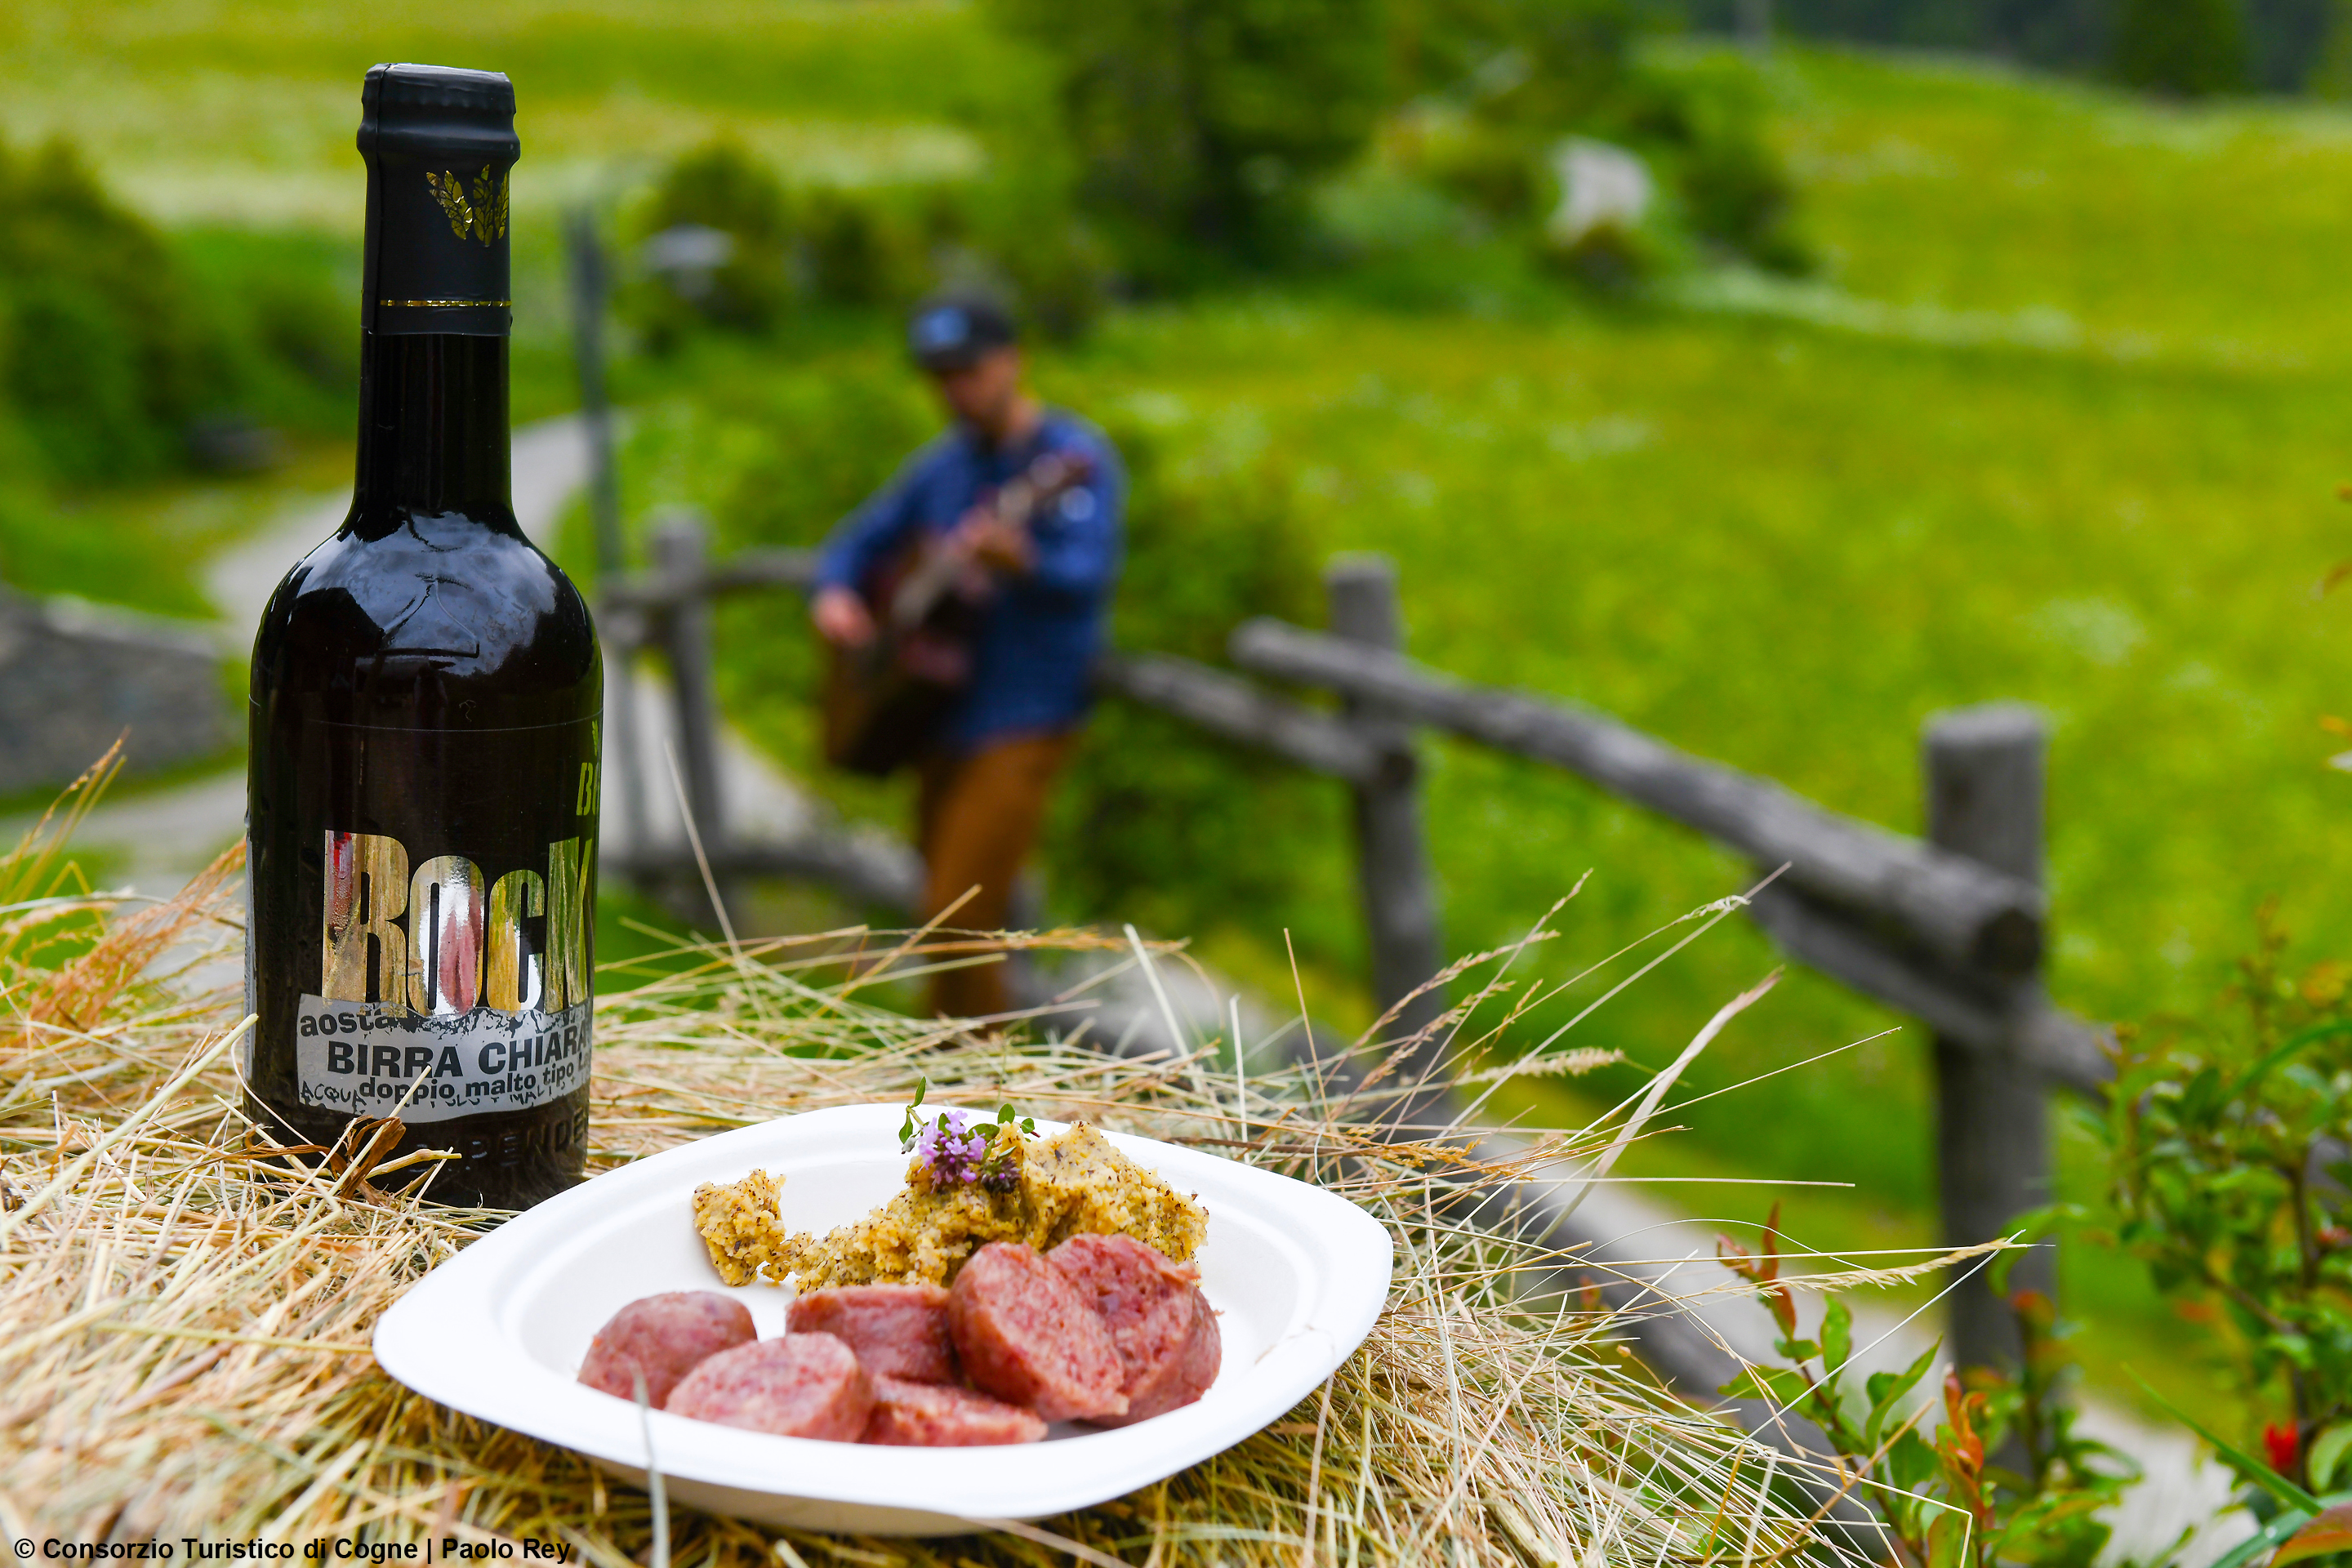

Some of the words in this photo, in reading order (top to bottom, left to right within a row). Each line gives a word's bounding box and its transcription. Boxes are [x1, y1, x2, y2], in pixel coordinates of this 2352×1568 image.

[327, 1040, 464, 1079] BIRRA
[478, 1020, 587, 1076] CHIARA
[359, 1076, 456, 1105] doppio
[465, 1072, 537, 1098] malto
[542, 1062, 574, 1088] tipo
